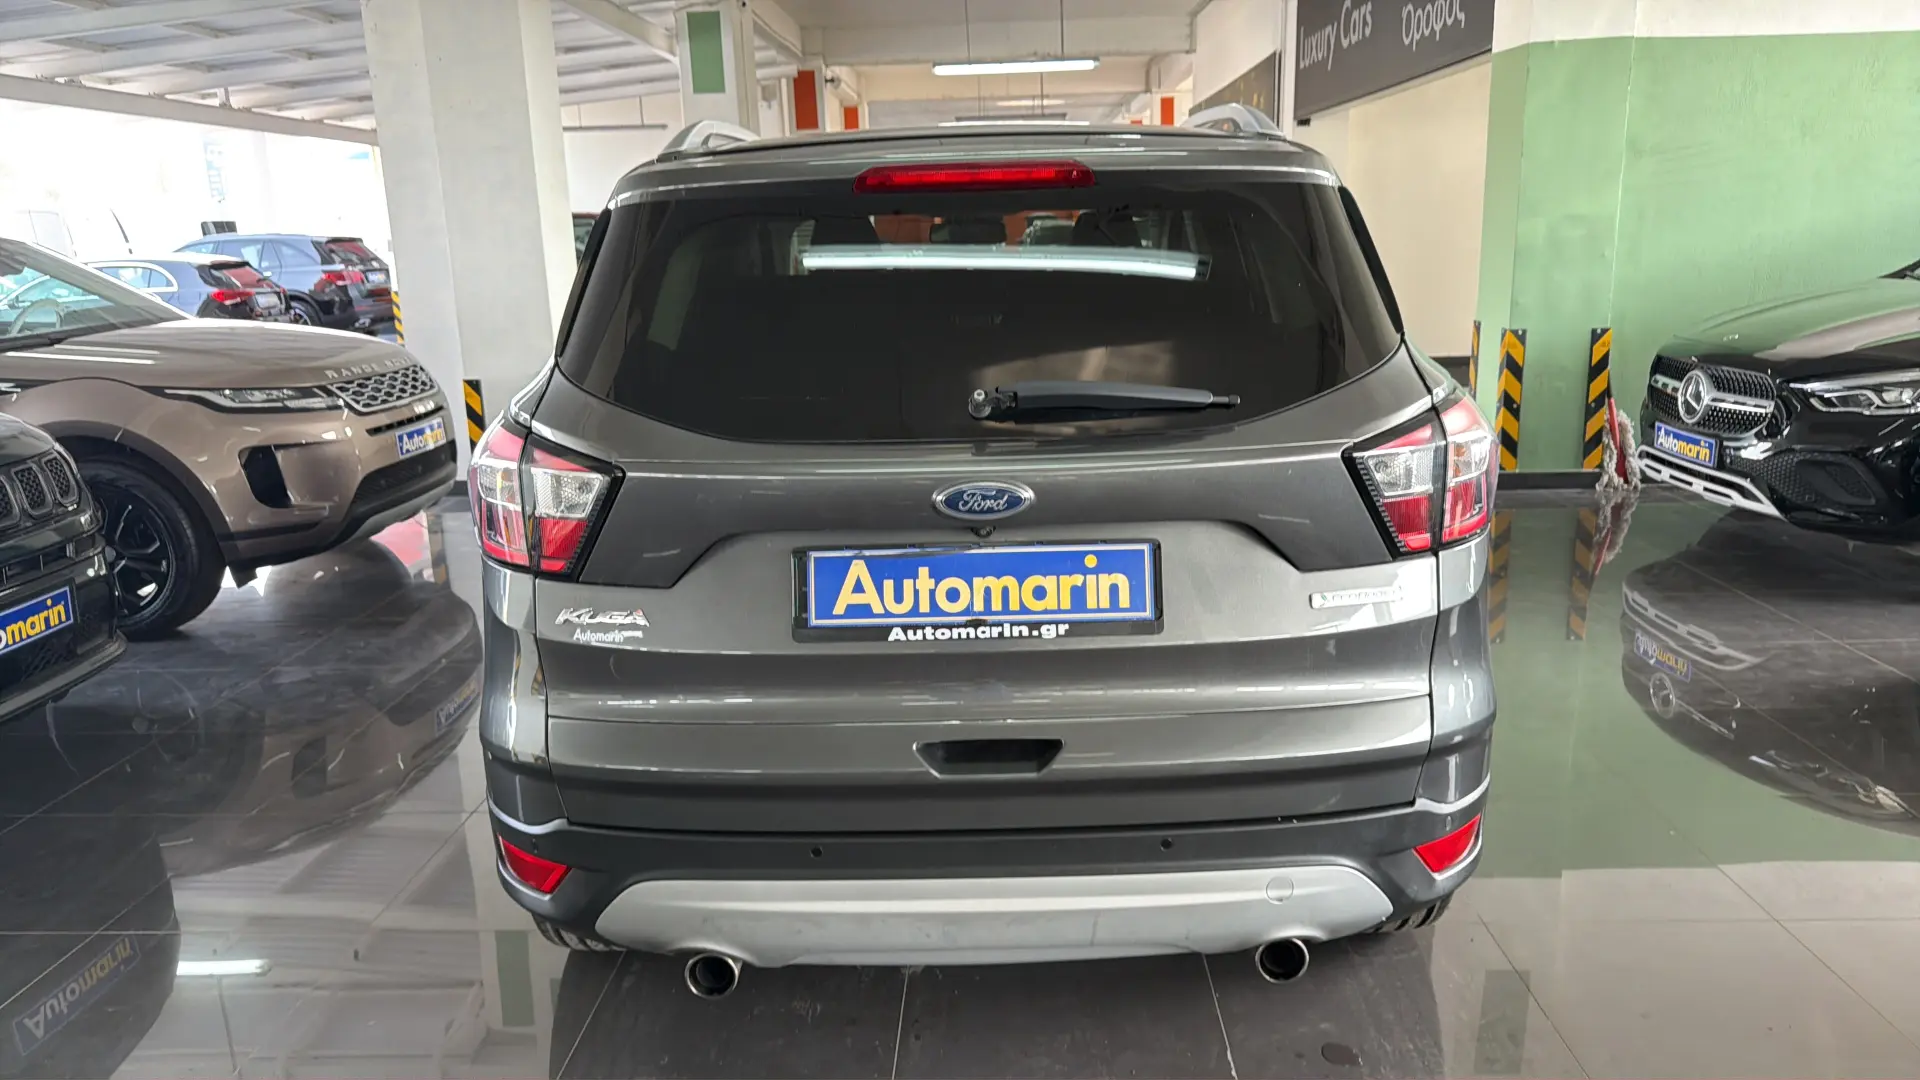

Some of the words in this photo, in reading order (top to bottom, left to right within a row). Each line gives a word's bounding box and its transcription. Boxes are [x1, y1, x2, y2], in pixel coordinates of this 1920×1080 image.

[1300, 21, 1338, 71] Luxury
[1339, 0, 1373, 49] Cars
[1657, 425, 1711, 463] Automarin
[958, 489, 1009, 512] Ford
[832, 553, 1131, 615] Automarin
[573, 627, 624, 643] Automarin
[887, 622, 1070, 642] Automarin.gr
